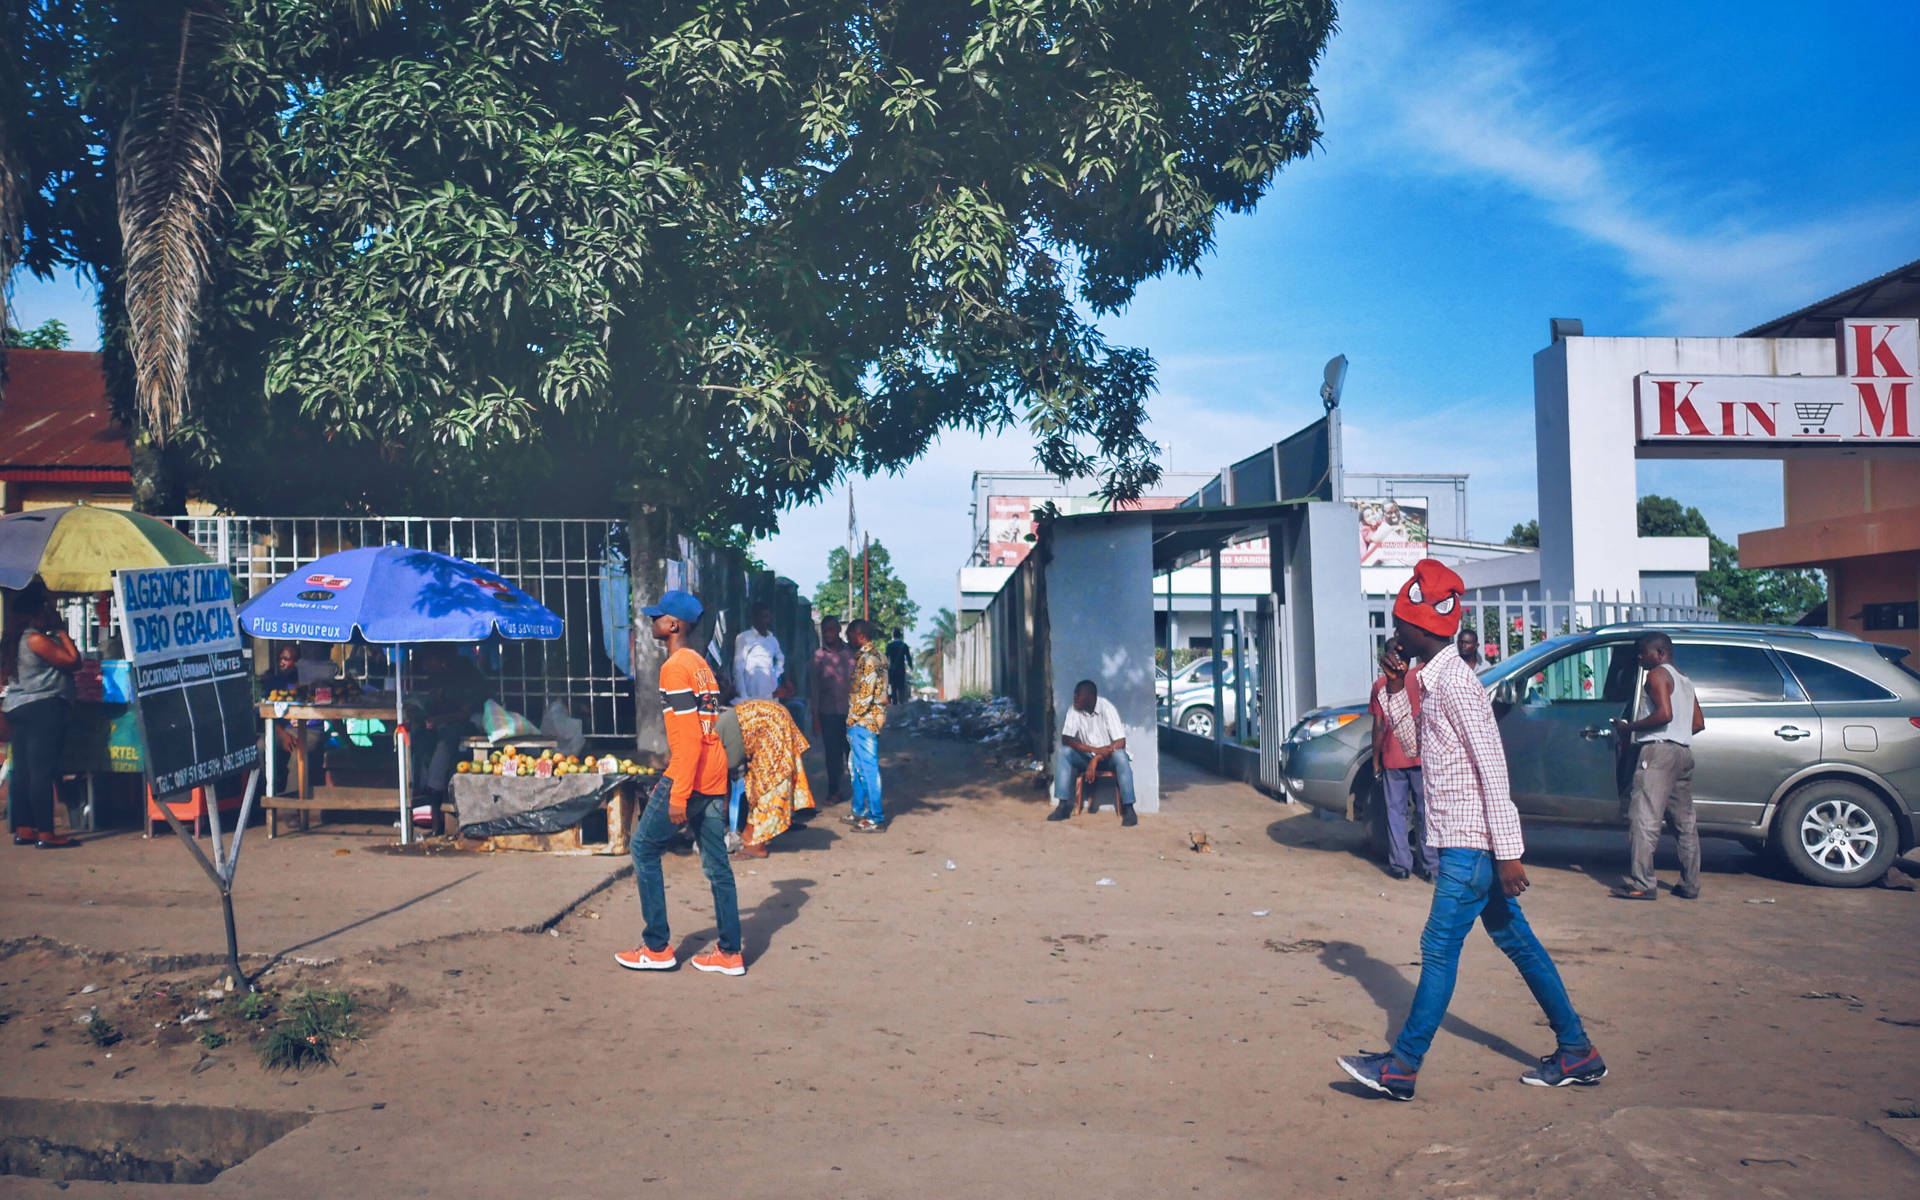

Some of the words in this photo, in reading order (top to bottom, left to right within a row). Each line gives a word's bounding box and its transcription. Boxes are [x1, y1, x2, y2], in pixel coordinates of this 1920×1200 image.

[1848, 325, 1913, 378] K
[1850, 382, 1920, 438] M
[125, 569, 190, 612] AGENCE
[193, 568, 232, 605] IMMO
[133, 613, 170, 653] DEO
[173, 606, 236, 647] GRACIA
[252, 617, 278, 633] Plus
[281, 622, 341, 638] savoureux
[211, 652, 241, 673] VENTES
[109, 745, 140, 761] RTEL
